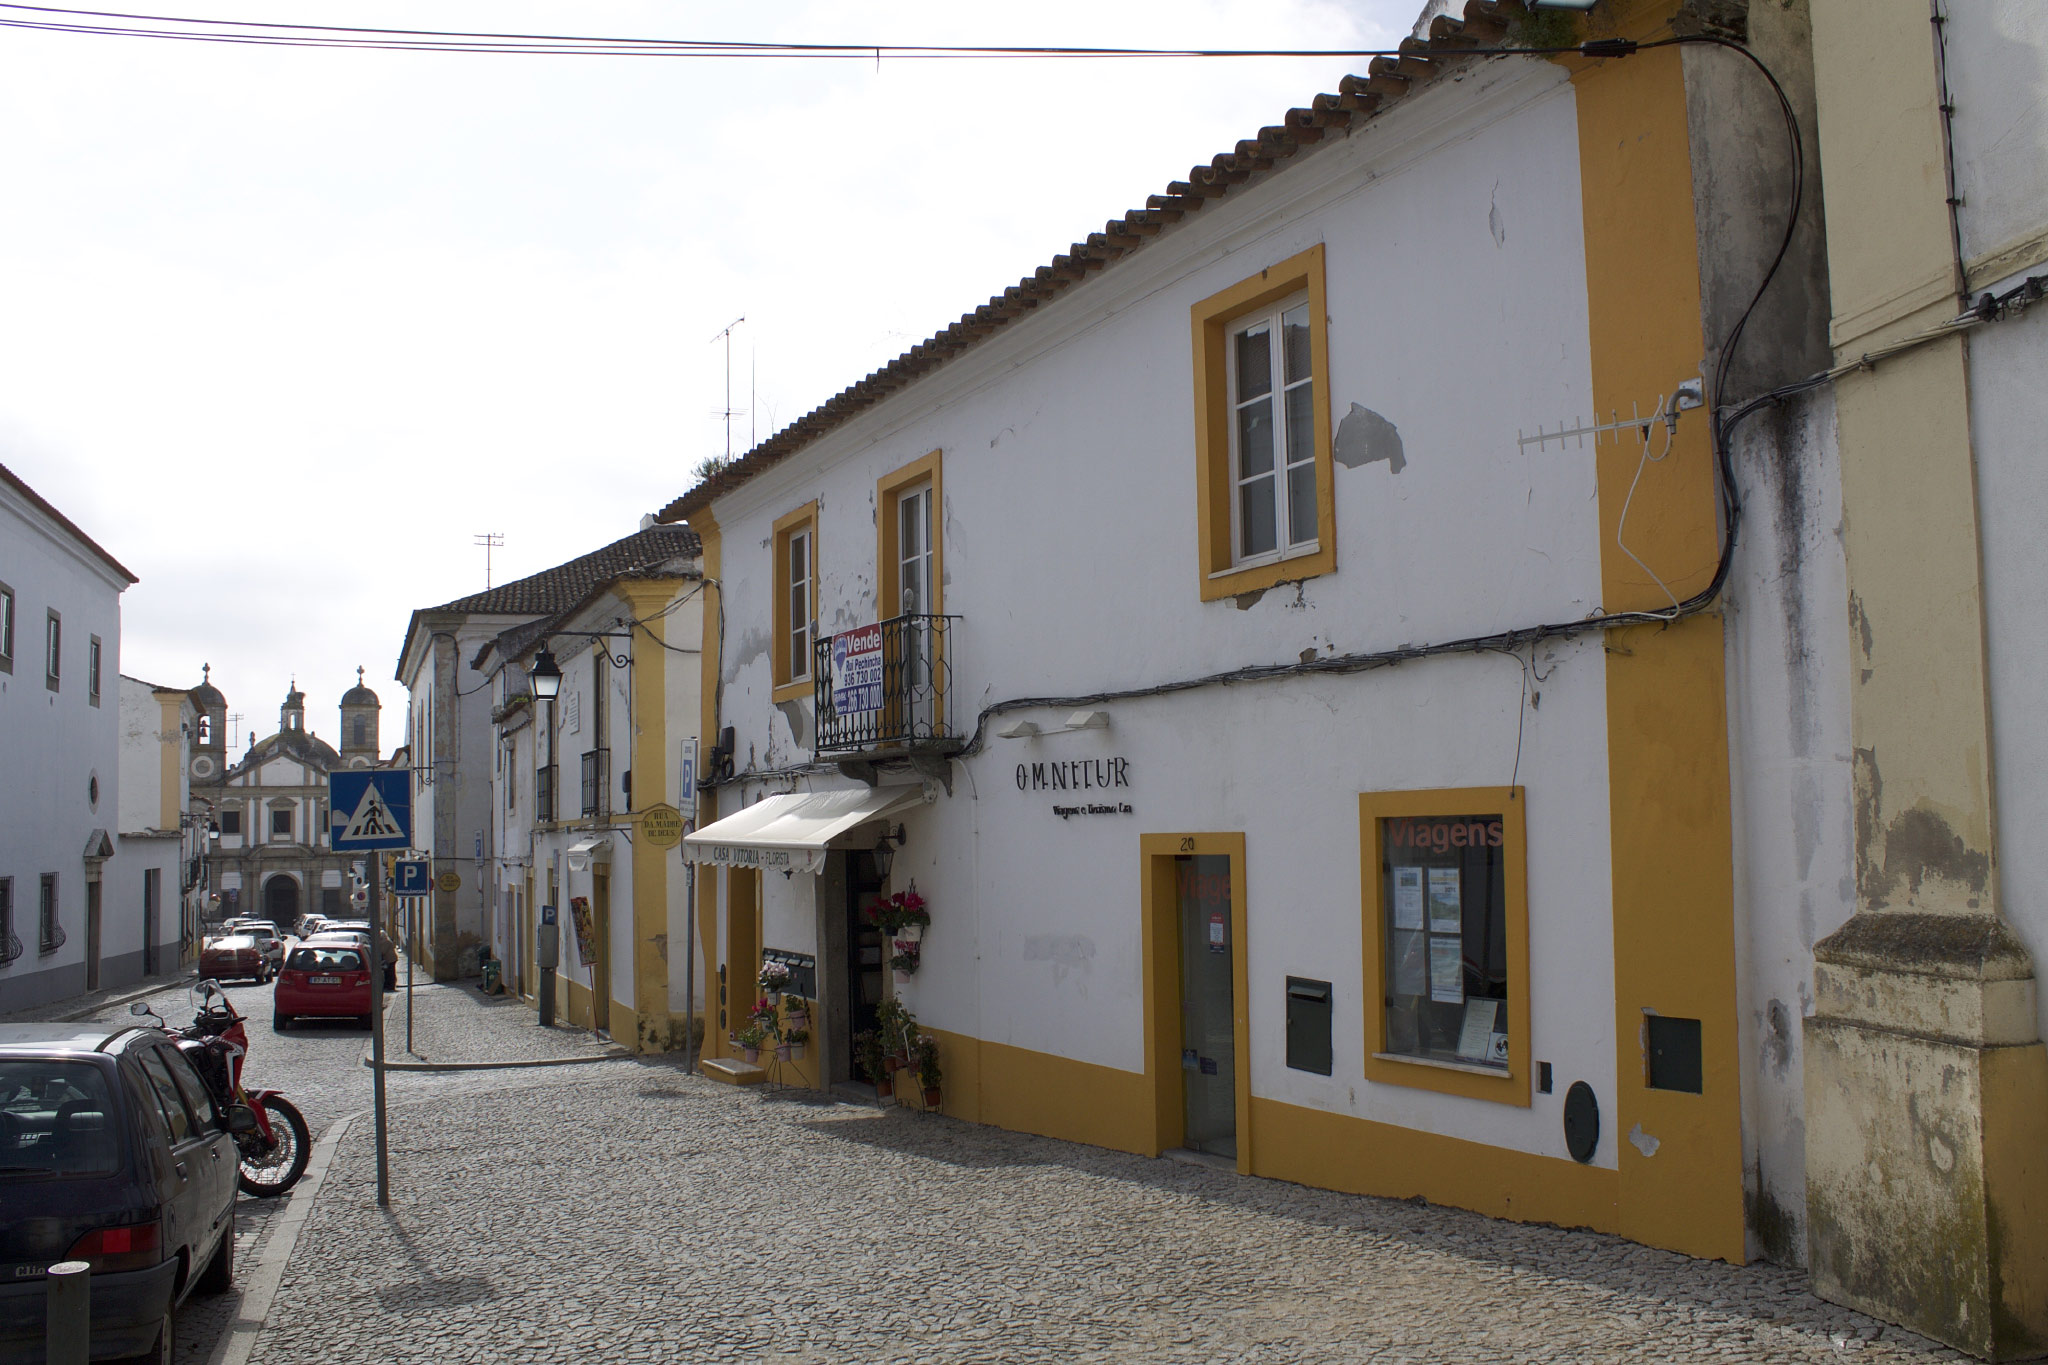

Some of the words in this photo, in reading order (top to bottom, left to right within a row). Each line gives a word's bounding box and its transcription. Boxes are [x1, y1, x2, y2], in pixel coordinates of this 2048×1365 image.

[847, 629, 880, 654] Vende
[855, 654, 881, 671] Pechincha
[856, 670, 868, 685] 730
[870, 667, 881, 683] 002
[870, 684, 881, 708] 000
[684, 764, 691, 793] P
[1016, 757, 1129, 791] OMNITUR
[644, 820, 654, 829] DA
[656, 820, 681, 829] MADRE
[654, 812, 669, 820] RUA
[648, 829, 657, 837] DE
[1387, 818, 1504, 854] Viagens
[1180, 837, 1195, 852] 20
[713, 846, 729, 861] CASA
[766, 851, 790, 866] FLORISTA
[404, 865, 417, 887] P
[545, 908, 555, 920] P
[15, 1265, 47, 1277] Clio
